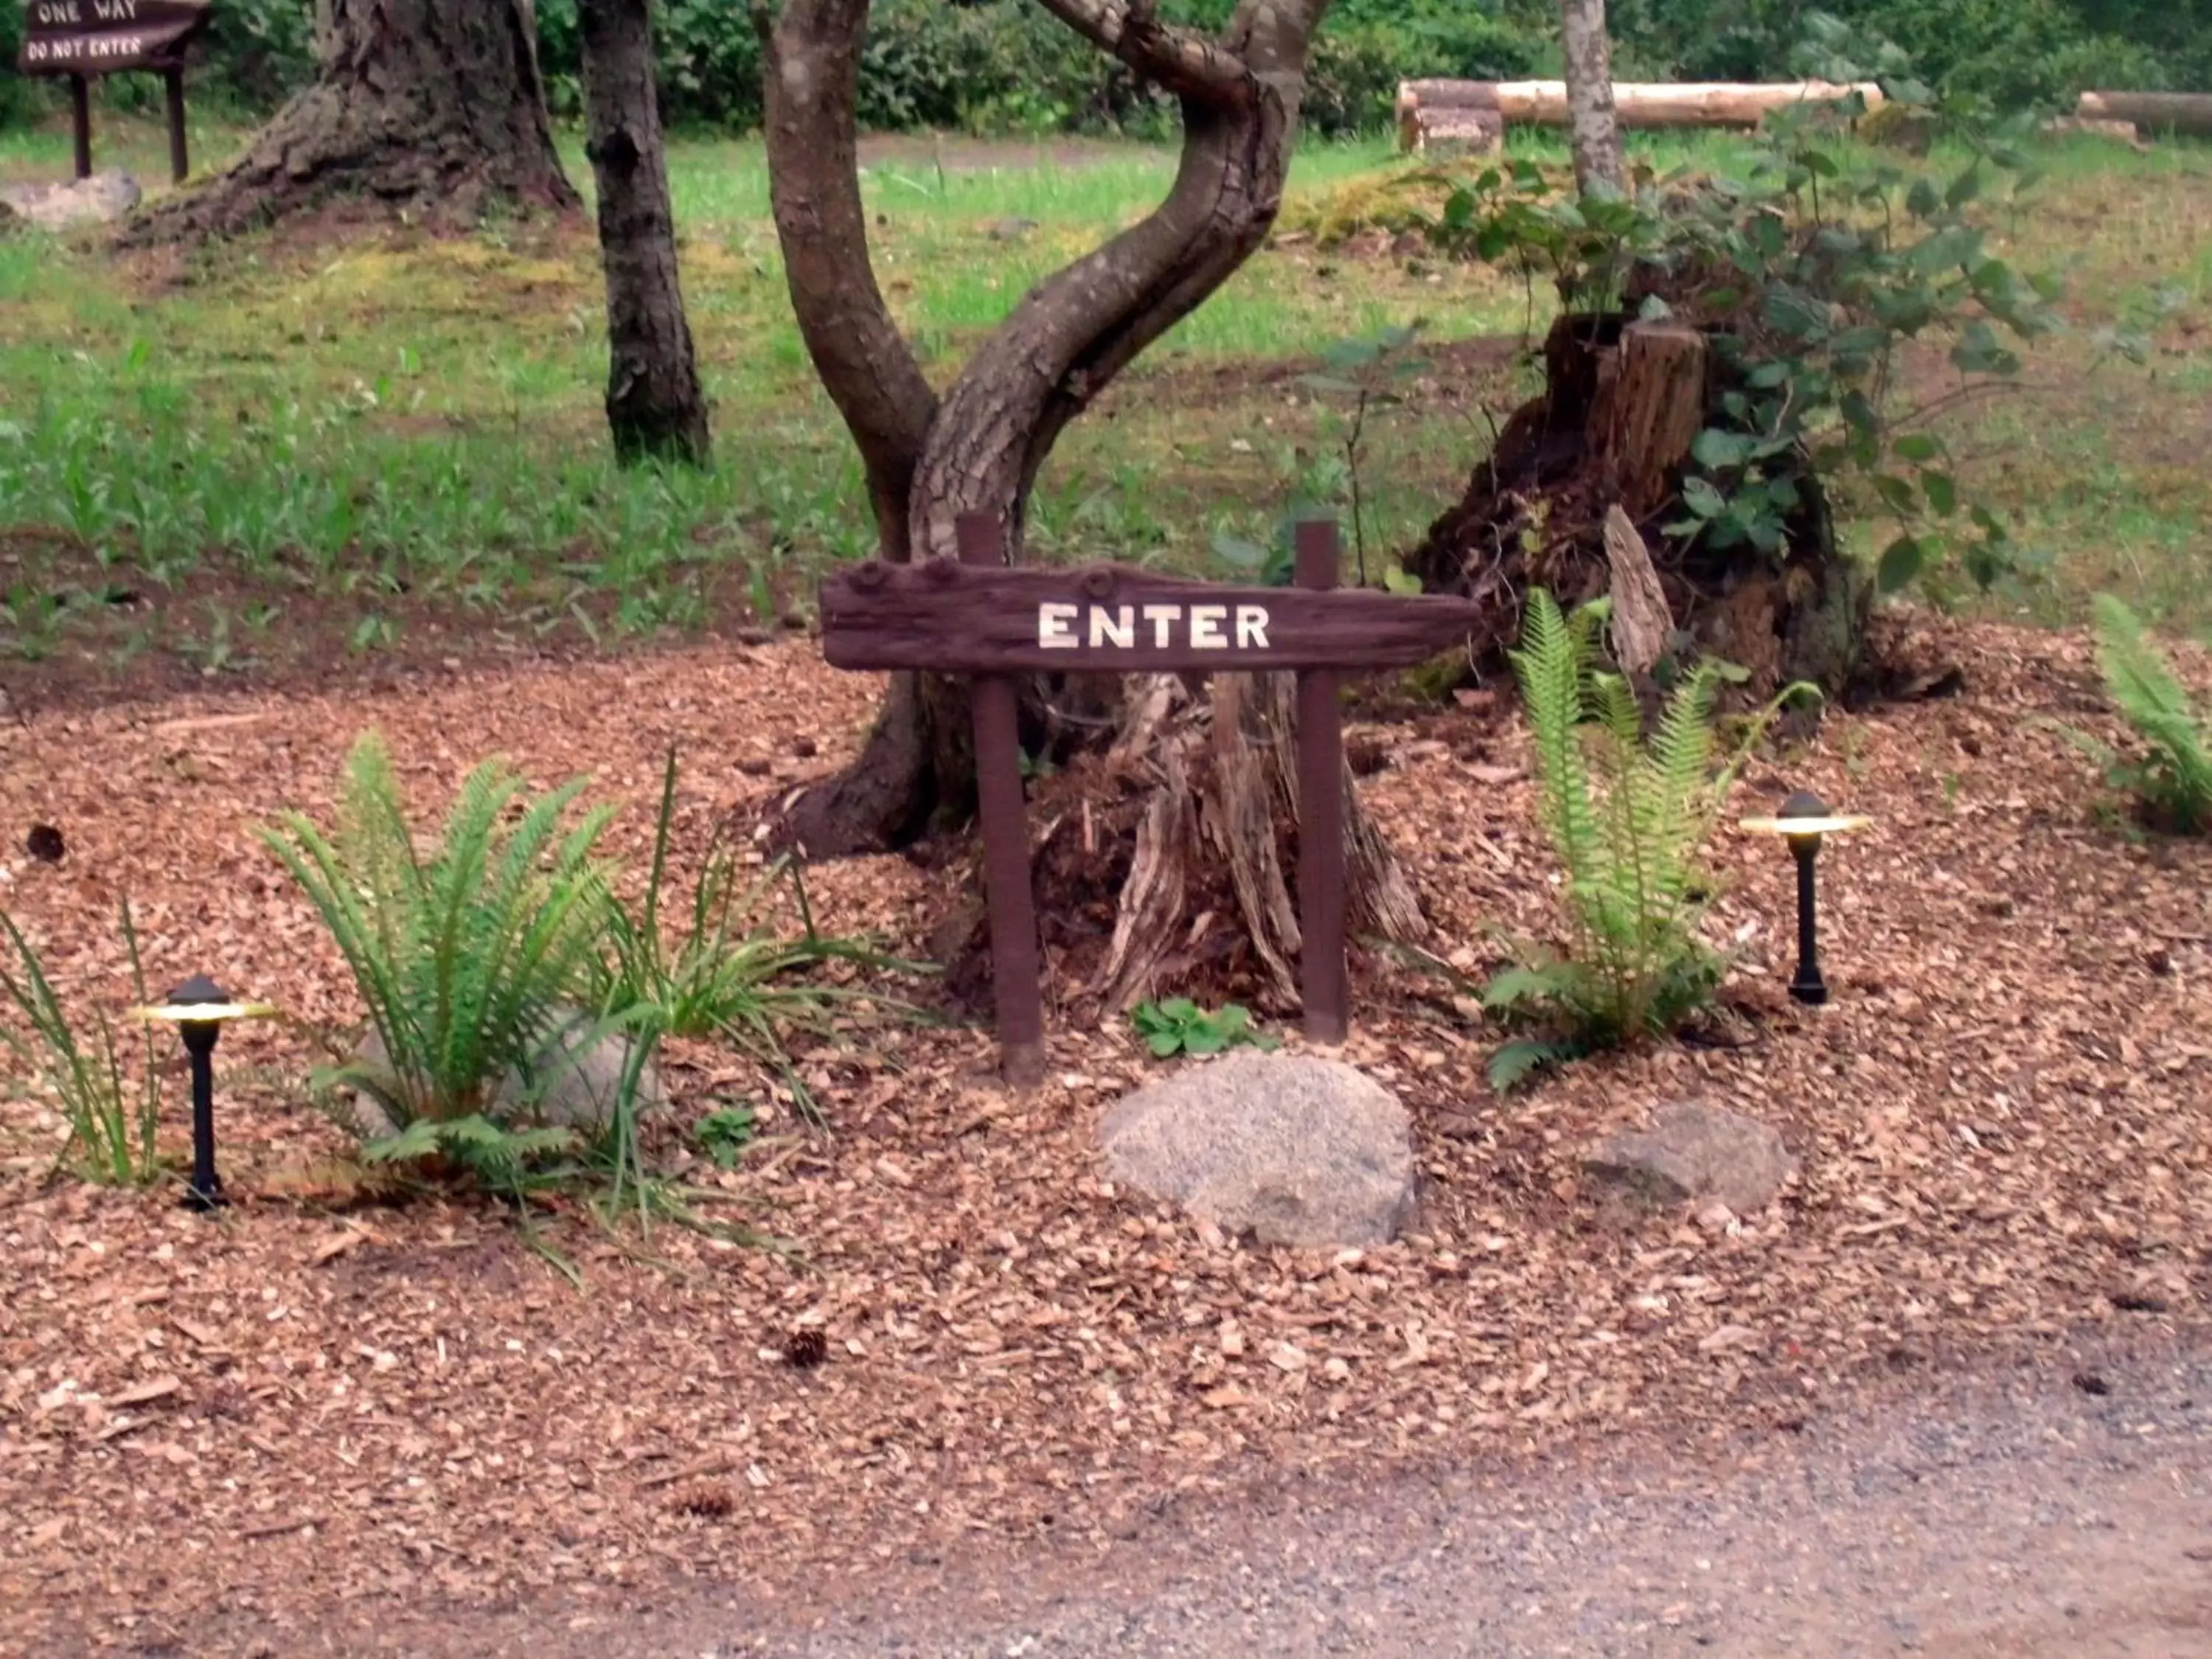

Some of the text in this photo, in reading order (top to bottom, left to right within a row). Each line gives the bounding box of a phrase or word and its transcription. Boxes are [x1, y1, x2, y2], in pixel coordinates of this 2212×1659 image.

[38, 0, 136, 24] ONE WAY
[27, 36, 141, 60] DO NOT ENTER
[1039, 602, 1270, 648] ENTER
